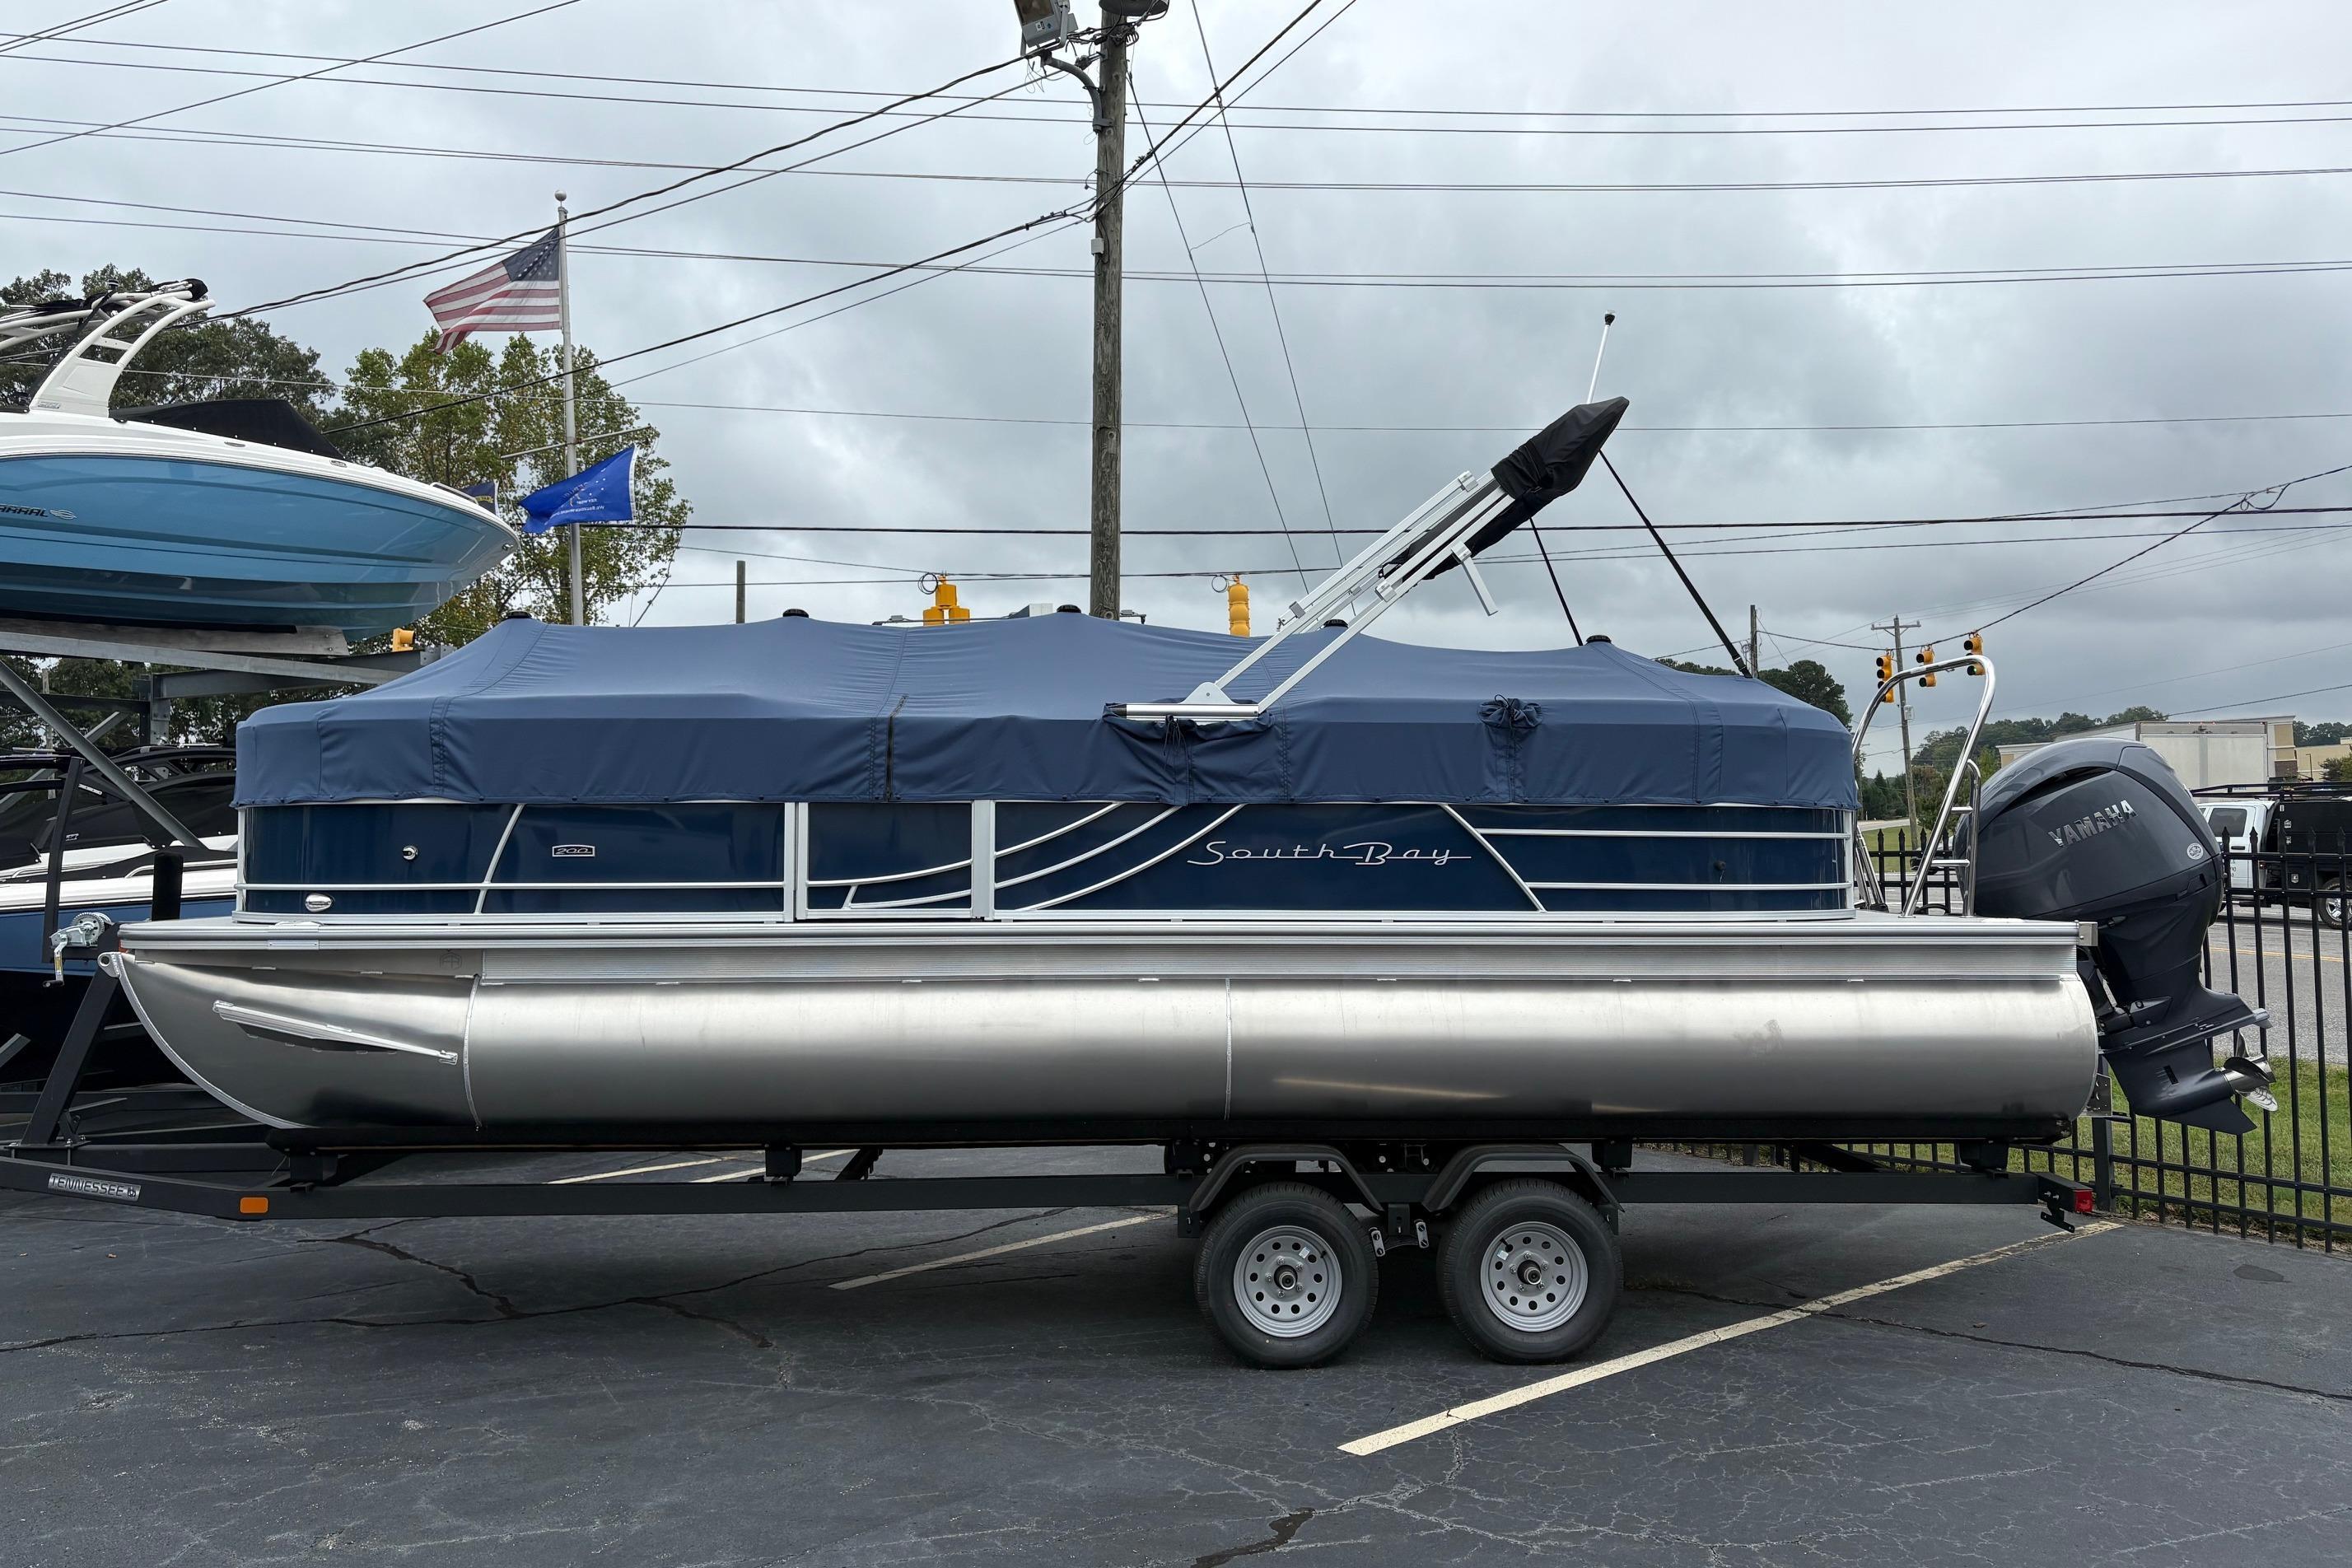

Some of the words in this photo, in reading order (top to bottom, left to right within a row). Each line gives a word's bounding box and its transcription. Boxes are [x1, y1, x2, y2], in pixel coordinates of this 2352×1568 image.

[2047, 800, 2138, 847] YAMAHA
[1188, 841, 1360, 865] South
[1343, 842, 1471, 866] Bay
[51, 1175, 124, 1197] TENNESSEE
